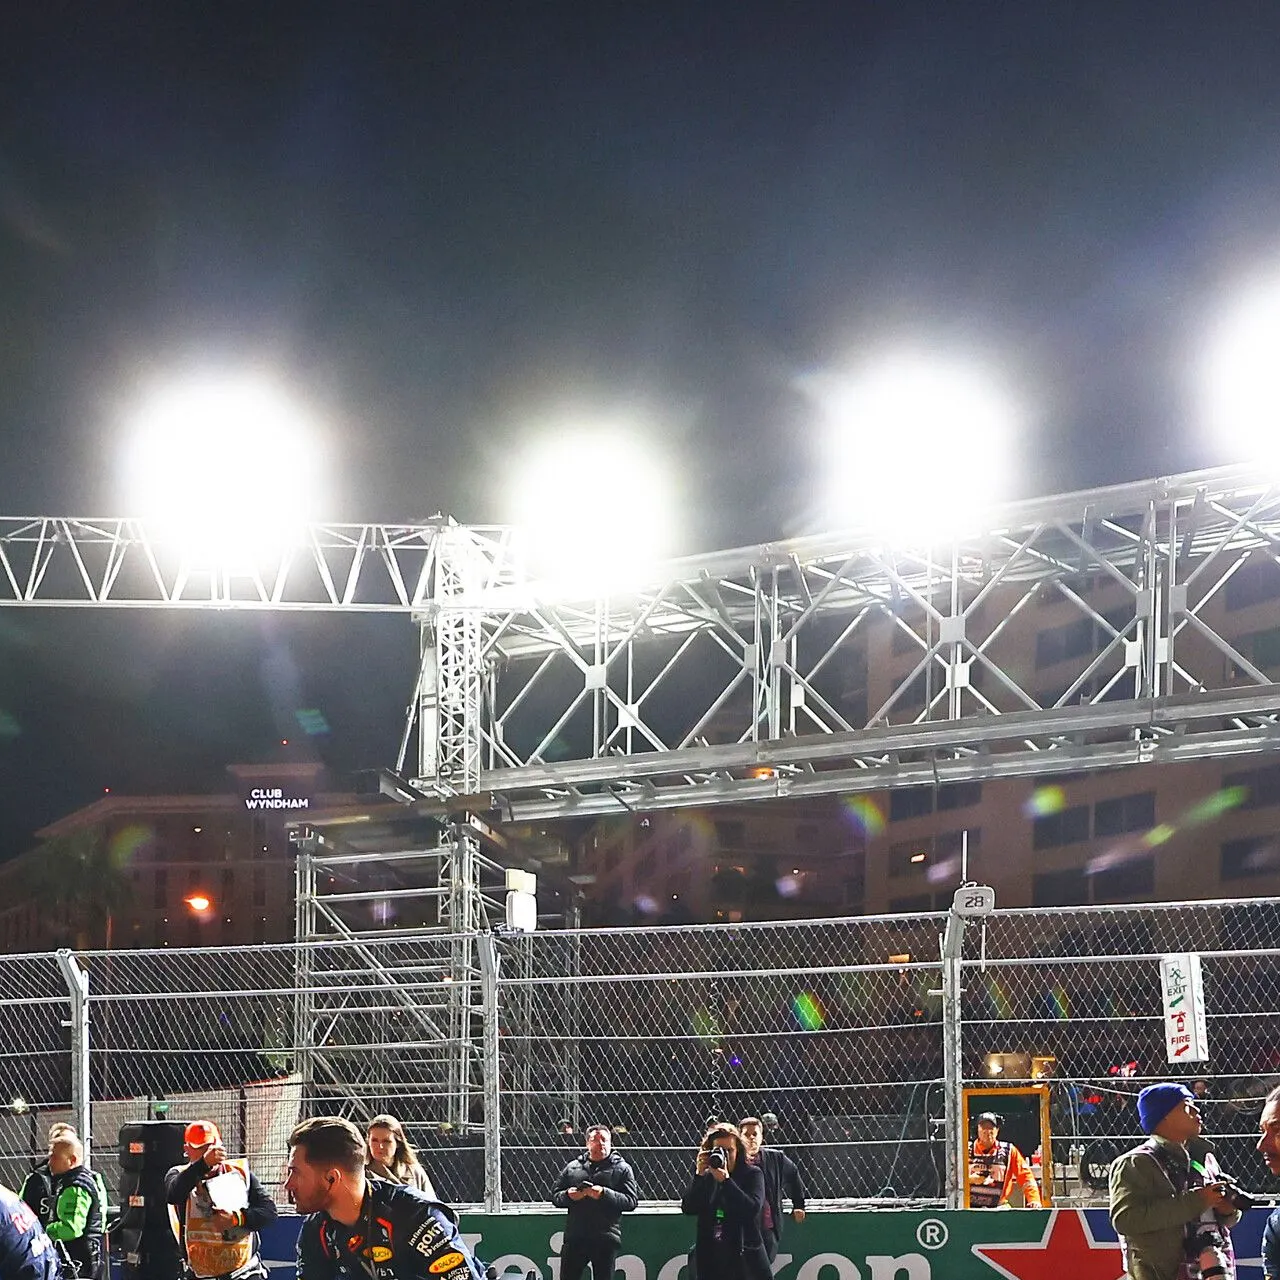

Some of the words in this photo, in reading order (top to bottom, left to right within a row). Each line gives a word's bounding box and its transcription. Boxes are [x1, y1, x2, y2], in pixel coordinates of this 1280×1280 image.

[251, 788, 283, 799] CLUB
[245, 799, 309, 809] WYNDHAM
[964, 896, 984, 908] 28
[1167, 985, 1188, 996] EXIT
[1171, 1034, 1191, 1045] FIRE
